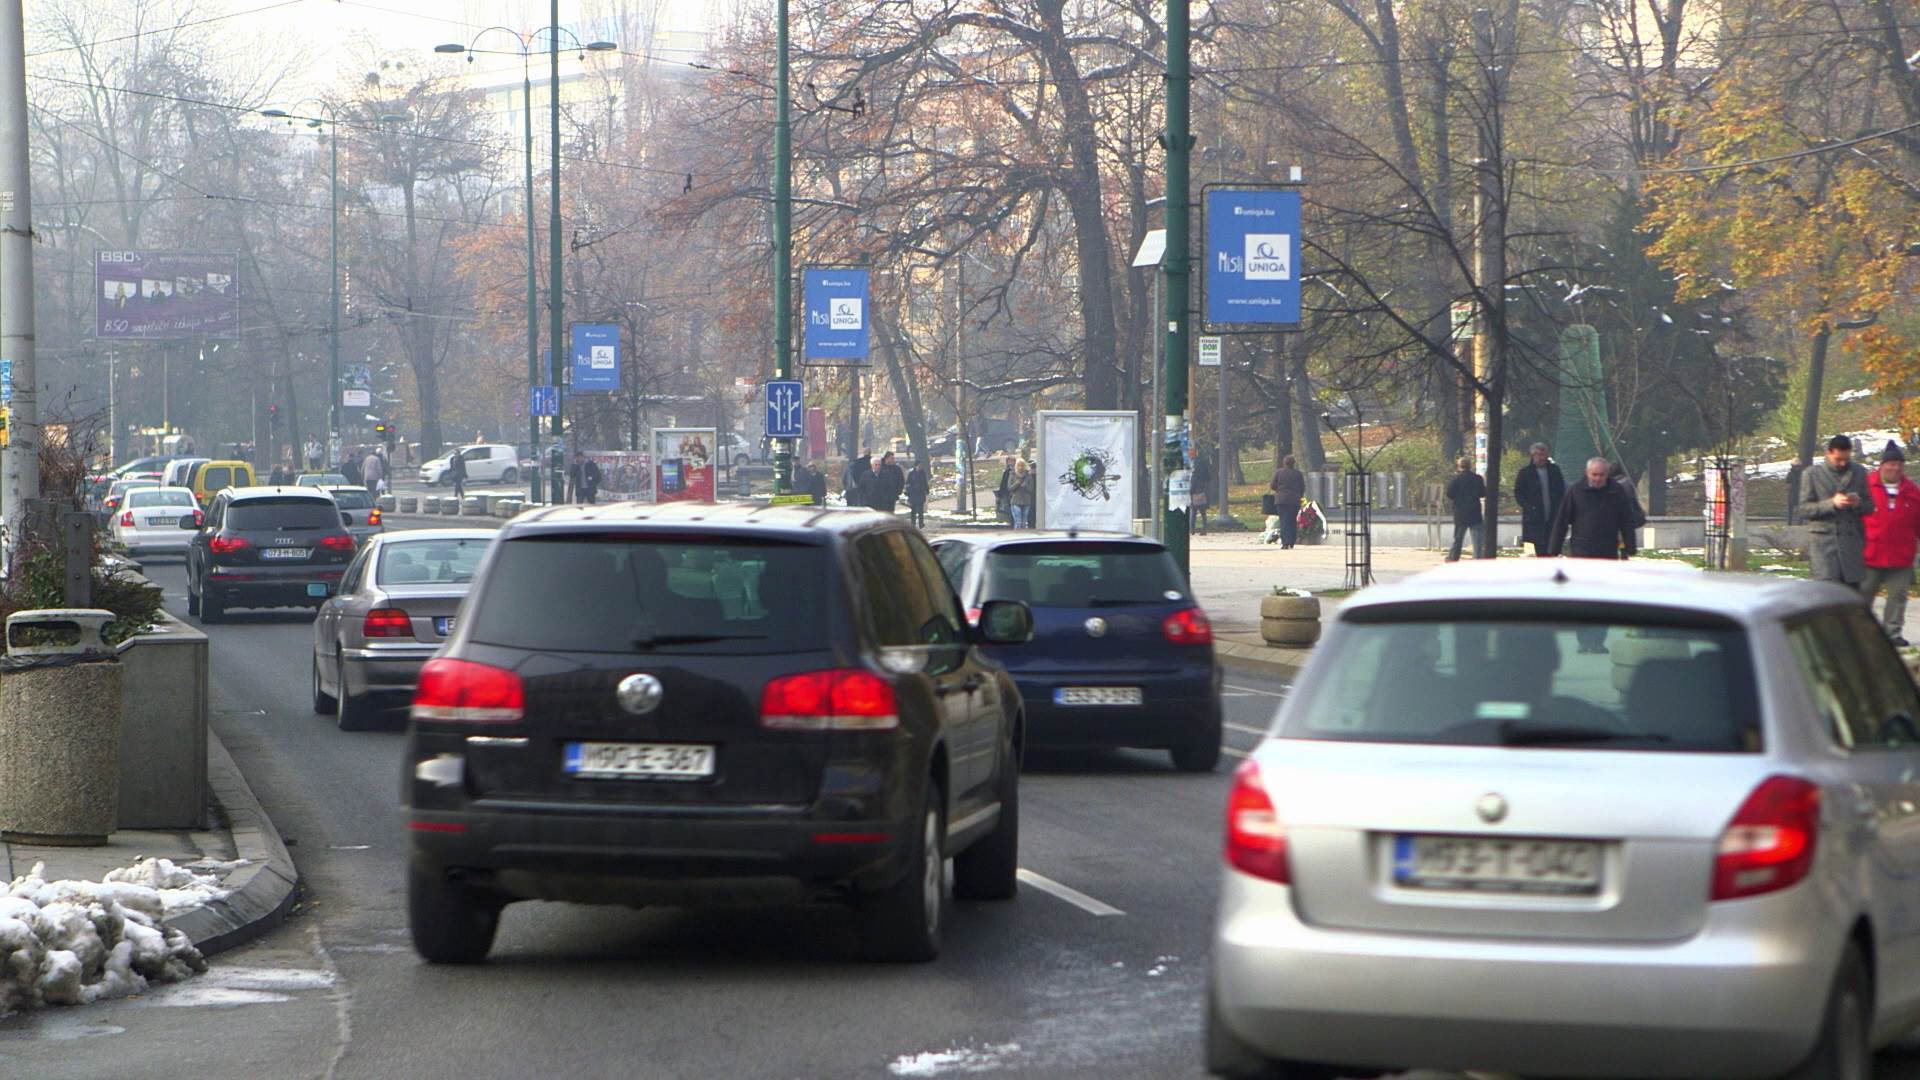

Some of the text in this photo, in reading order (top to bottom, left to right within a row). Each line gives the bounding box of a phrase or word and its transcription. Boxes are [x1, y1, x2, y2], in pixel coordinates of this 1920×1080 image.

[1242, 207, 1275, 217] uniqa.ba
[1248, 262, 1286, 273] UNIQA
[1227, 297, 1281, 306] www.uniqa.ba
[833, 317, 859, 325] UNIQA
